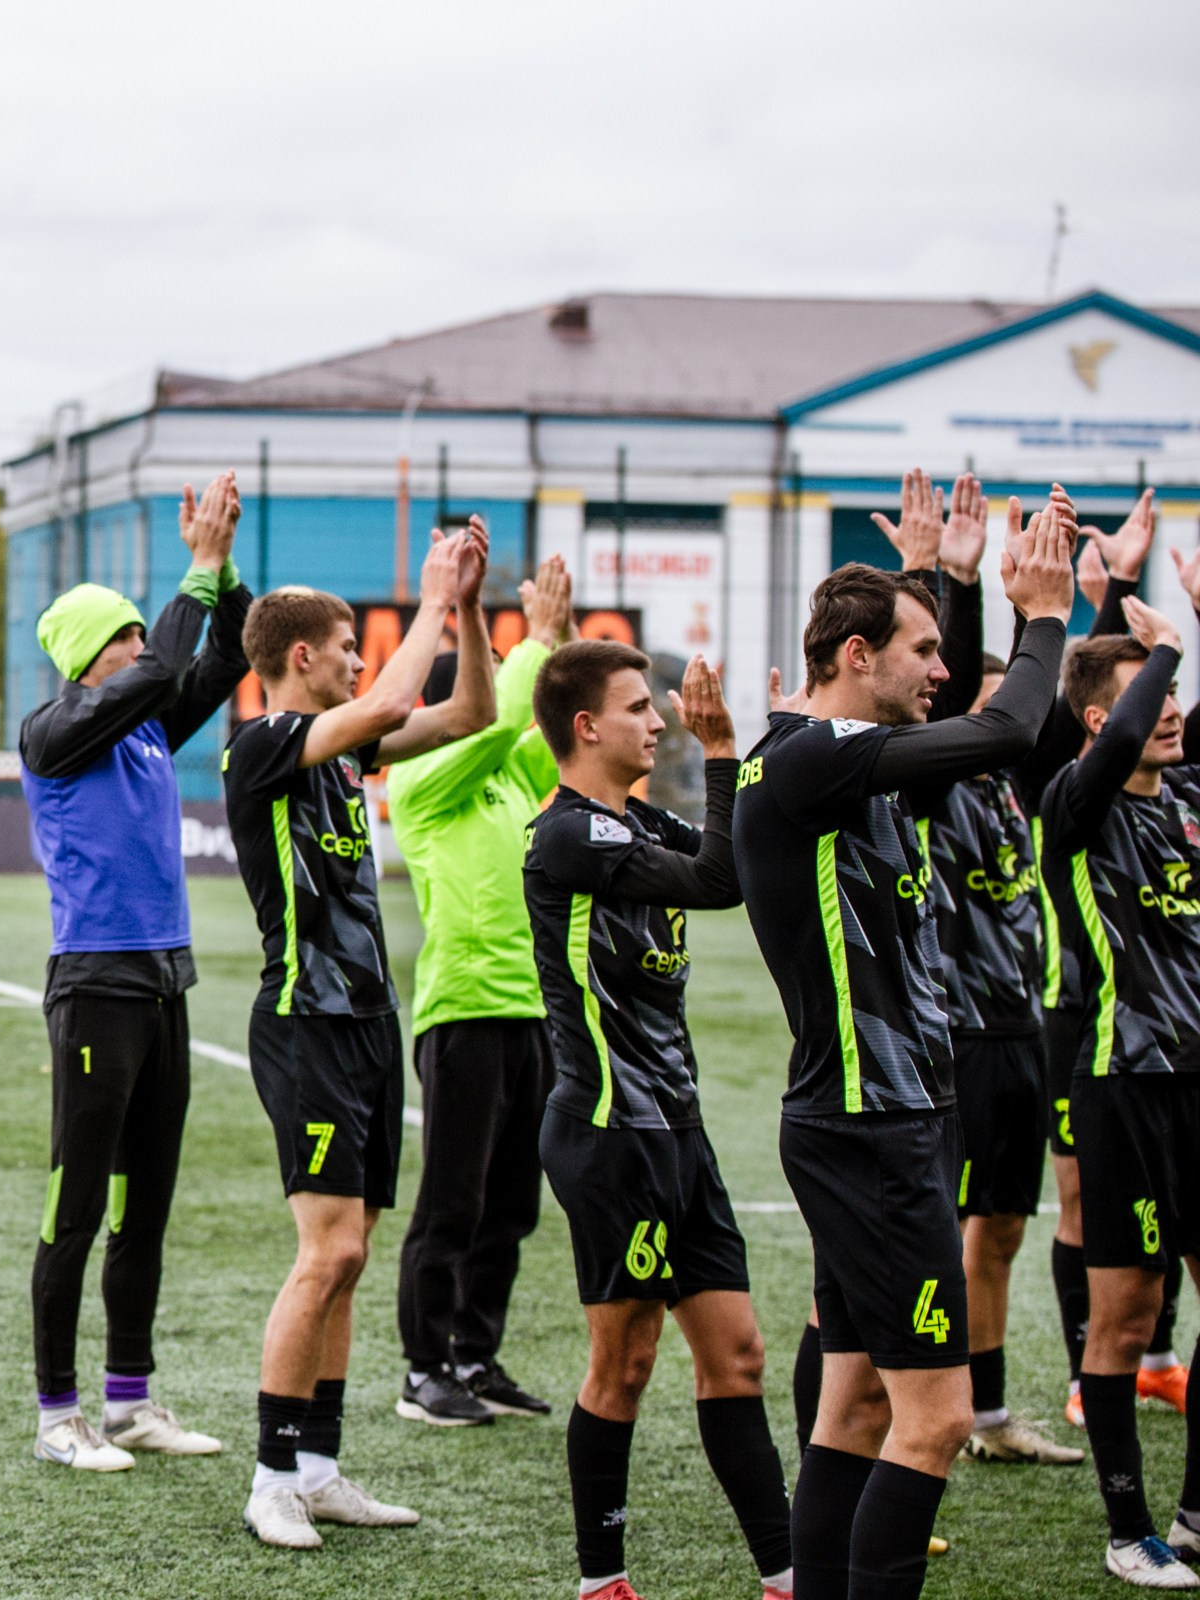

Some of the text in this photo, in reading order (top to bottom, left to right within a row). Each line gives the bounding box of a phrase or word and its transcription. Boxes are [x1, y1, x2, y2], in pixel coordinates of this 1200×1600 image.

[80, 1046, 91, 1074] 1
[306, 1122, 335, 1175] 7
[913, 1279, 950, 1344] 4
